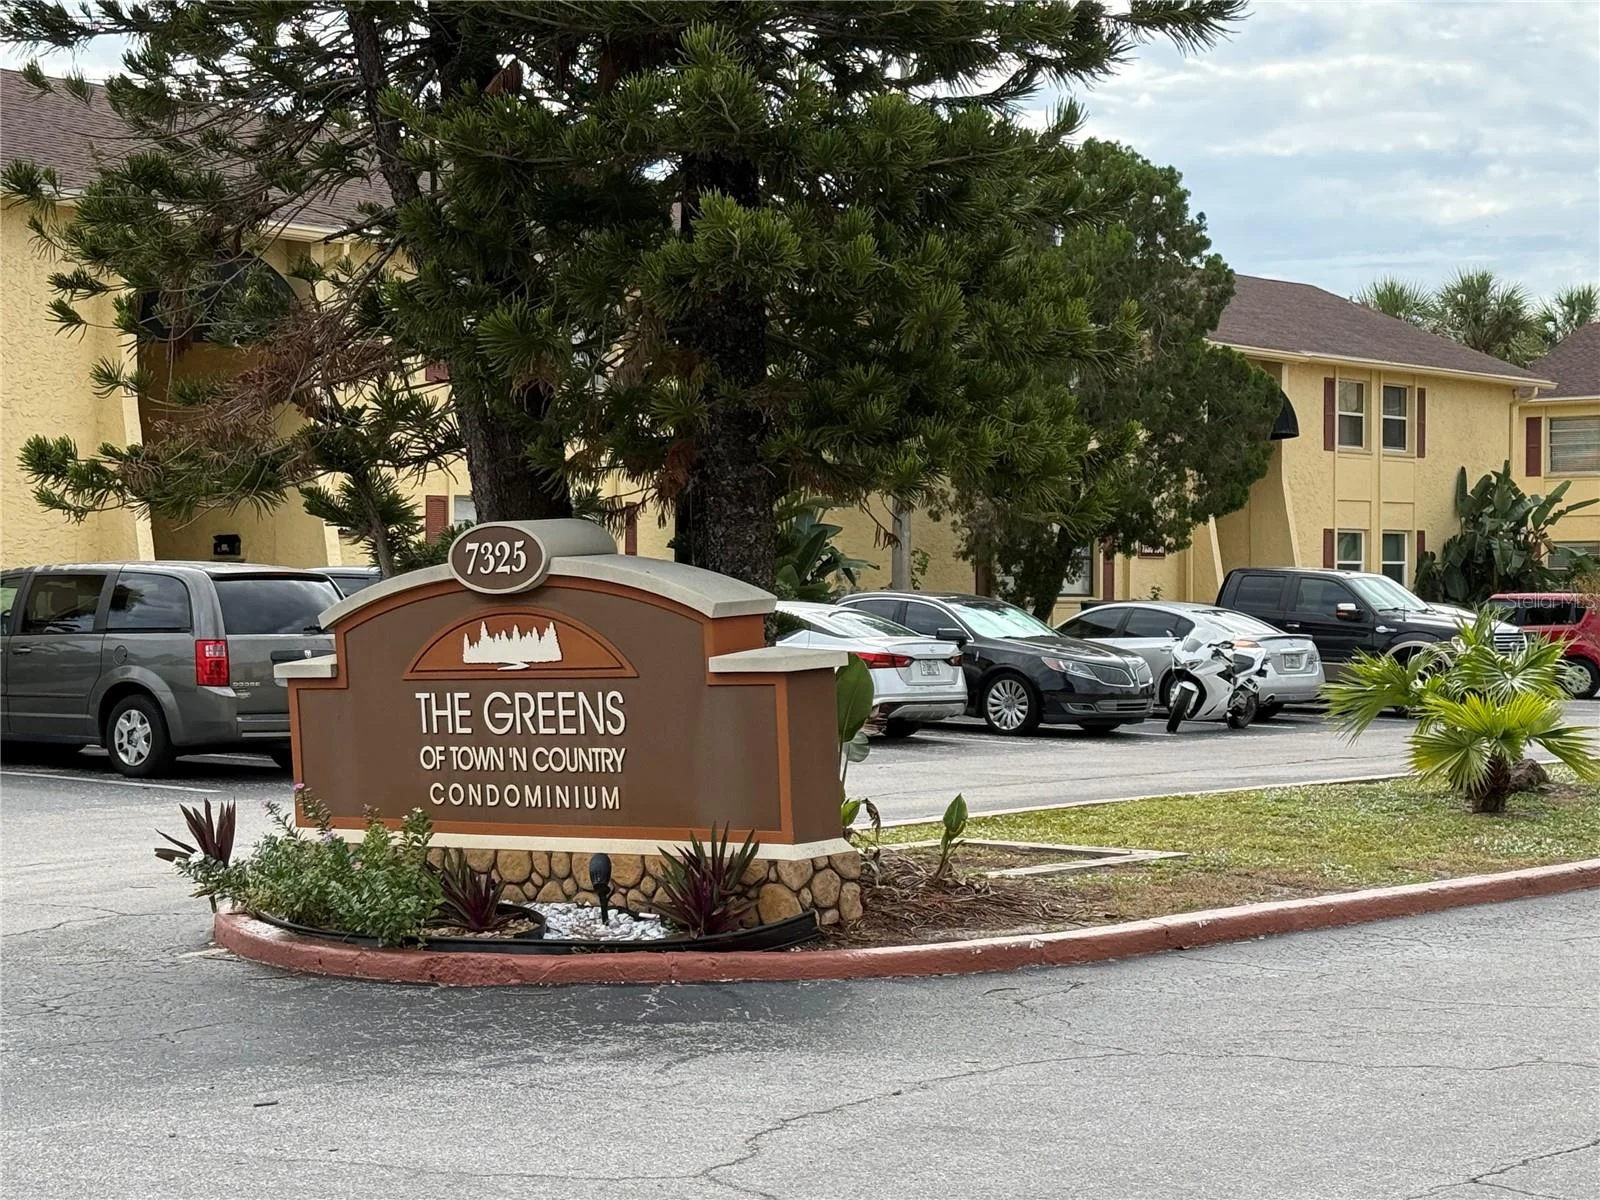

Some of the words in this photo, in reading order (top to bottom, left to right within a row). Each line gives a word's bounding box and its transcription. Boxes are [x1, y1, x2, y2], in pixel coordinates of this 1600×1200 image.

[465, 540, 527, 575] 7325
[415, 692, 472, 734] THE
[483, 690, 626, 735] GREENS
[420, 745, 446, 770] OF
[450, 746, 504, 771] TOWN
[532, 747, 626, 773] COUNTRY
[430, 782, 620, 810] CONDOMINIUM
